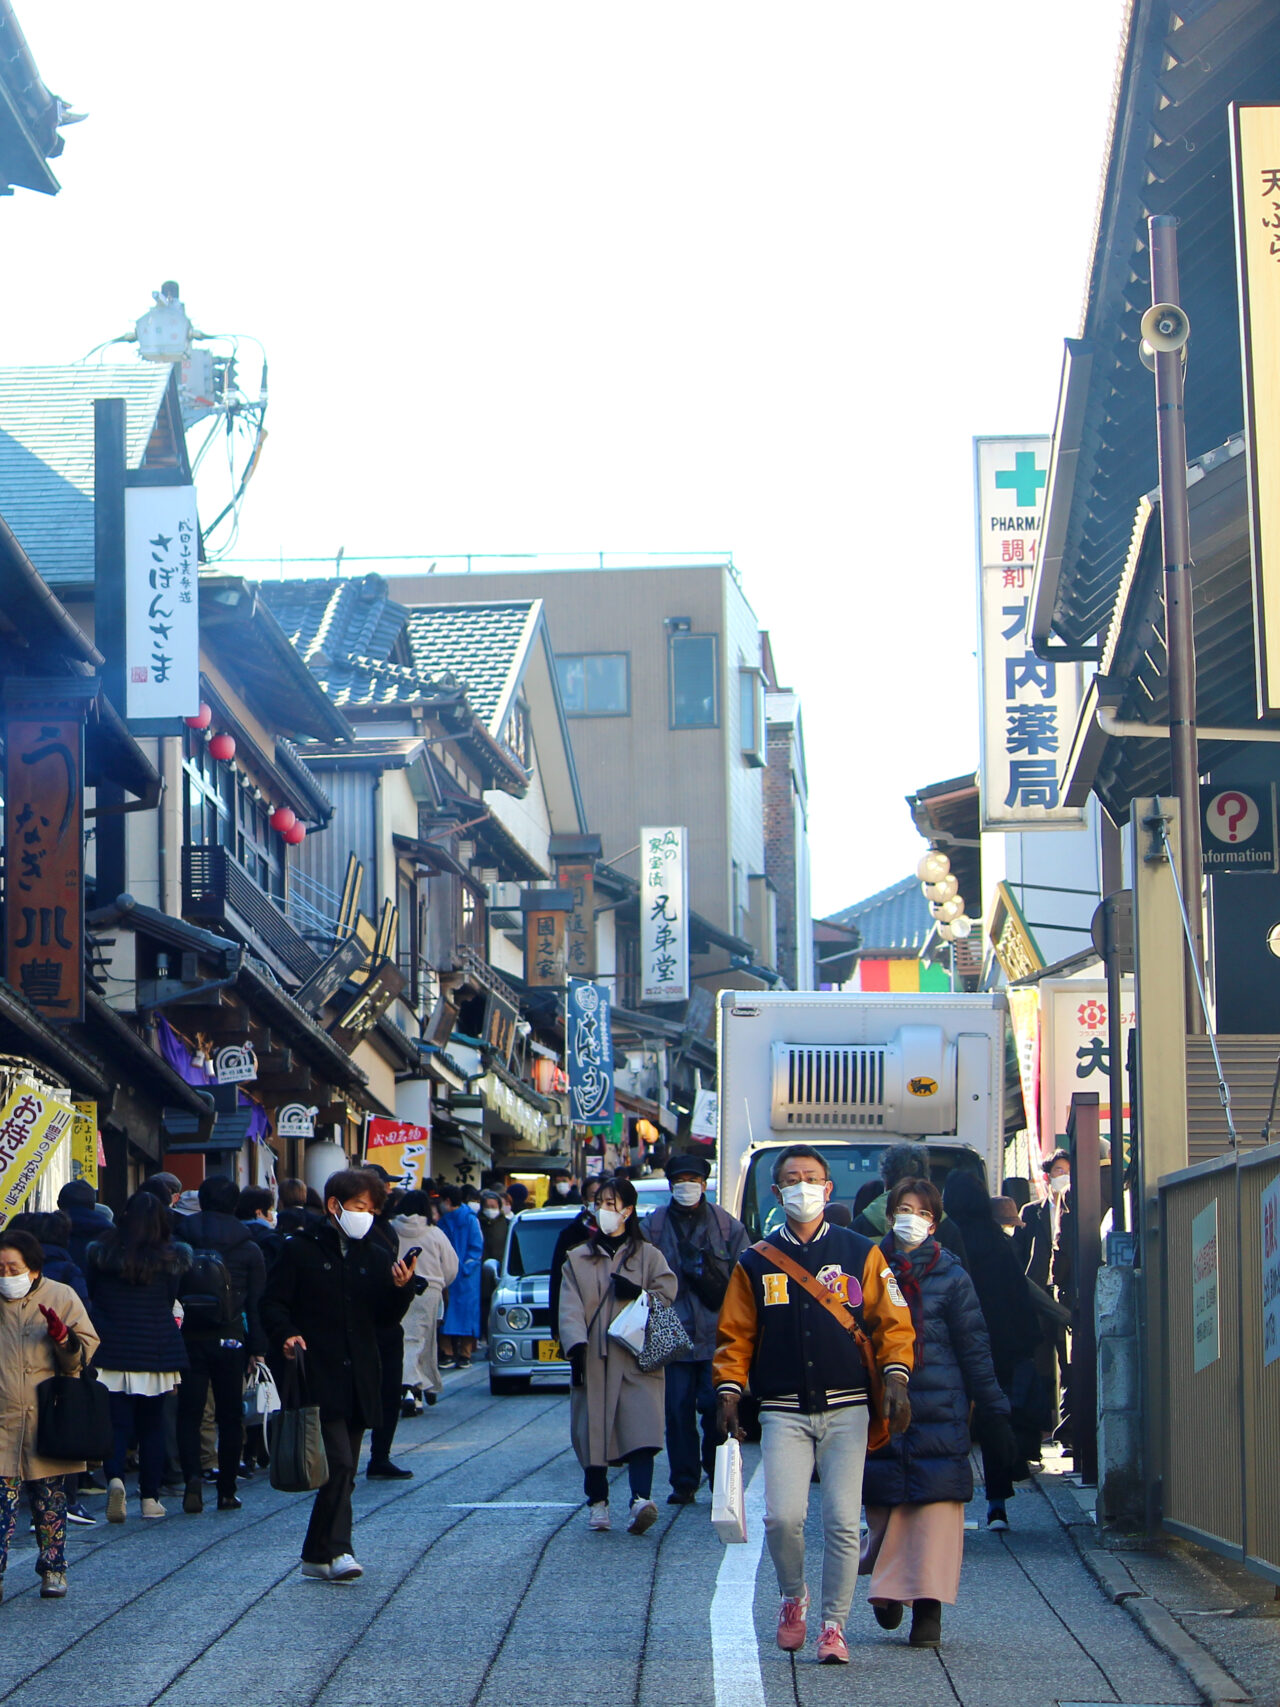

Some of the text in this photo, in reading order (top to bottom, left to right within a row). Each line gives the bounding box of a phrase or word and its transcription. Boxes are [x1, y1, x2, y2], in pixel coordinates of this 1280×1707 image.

[1200, 847, 1272, 864] nformation
[650, 893, 678, 983] 兄弟堂
